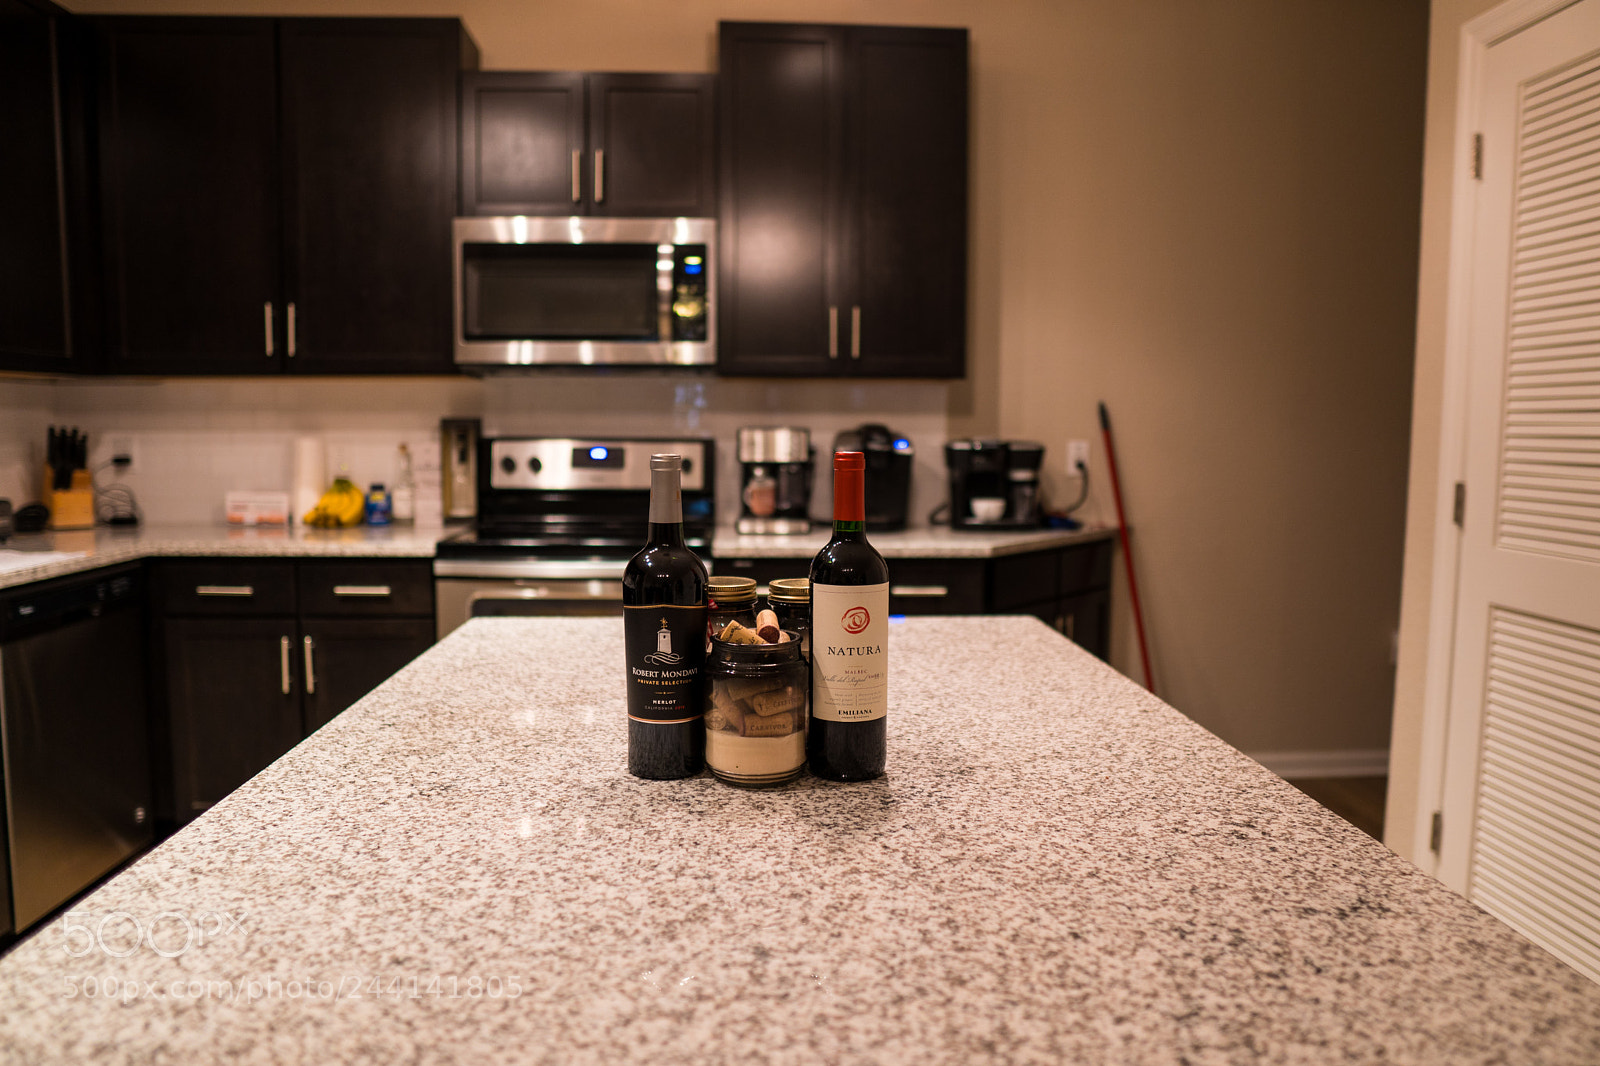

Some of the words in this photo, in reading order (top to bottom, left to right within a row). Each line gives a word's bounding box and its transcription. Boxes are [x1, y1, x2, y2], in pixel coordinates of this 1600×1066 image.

[827, 645, 881, 656] NATURA
[632, 666, 659, 678] ROBERT
[661, 667, 698, 678] MONDAVI
